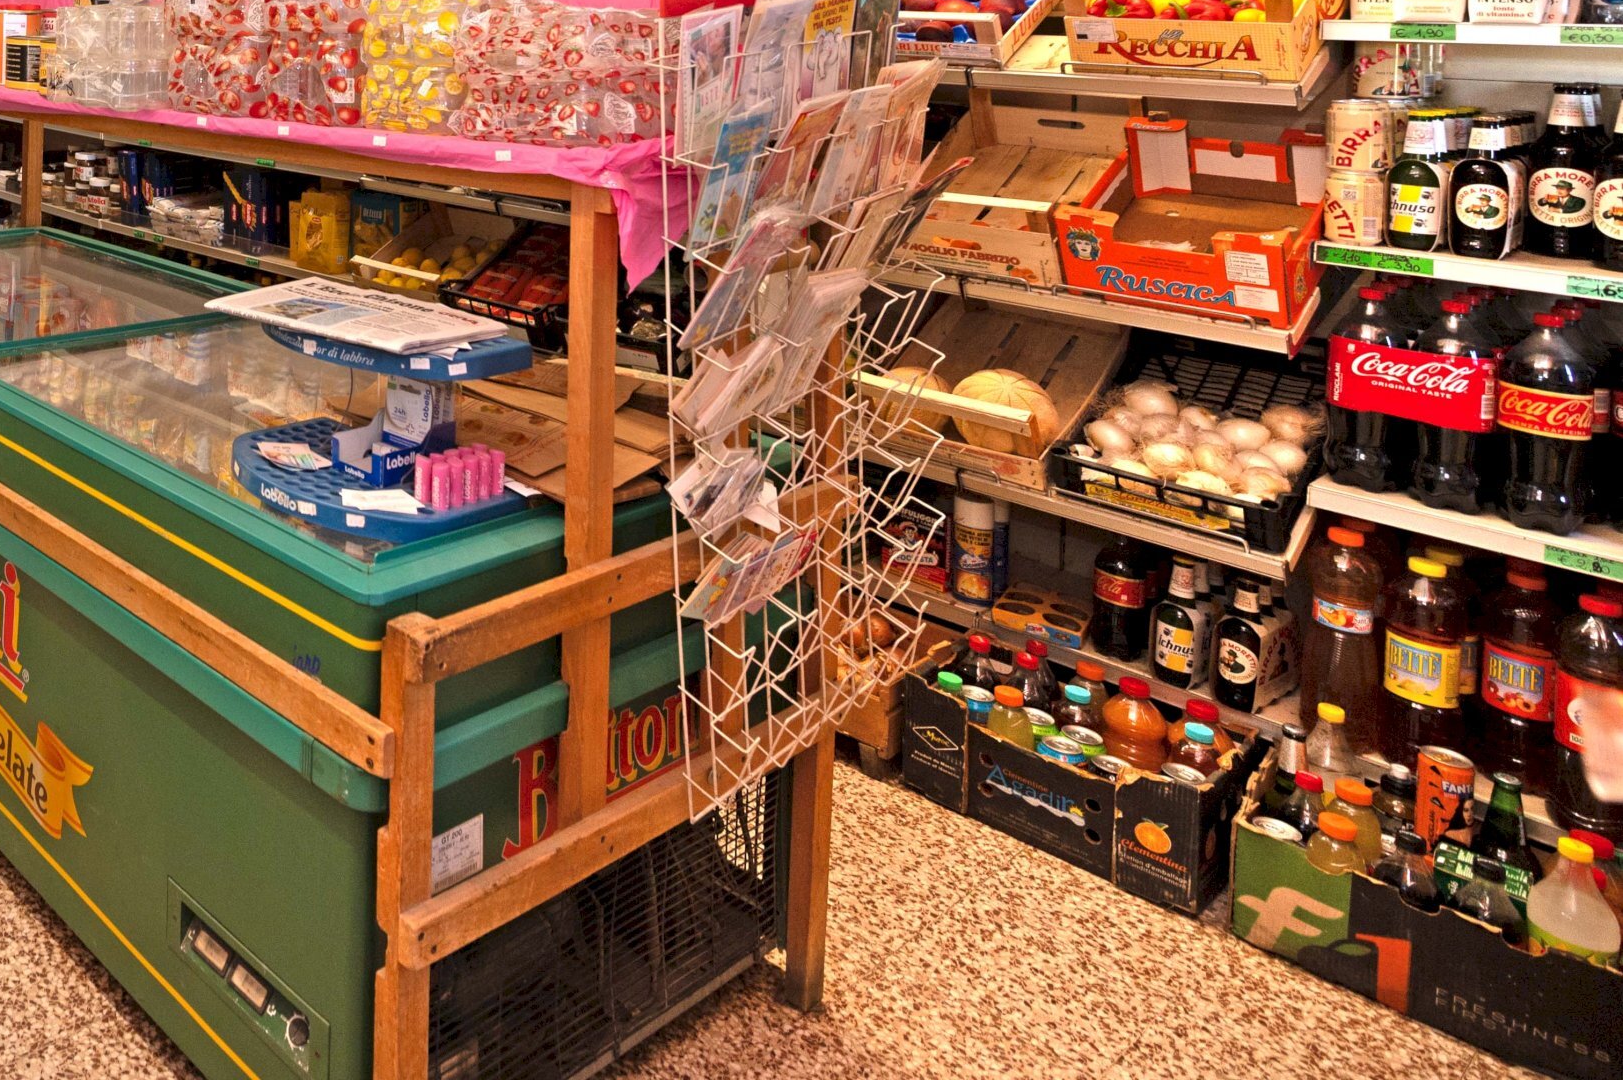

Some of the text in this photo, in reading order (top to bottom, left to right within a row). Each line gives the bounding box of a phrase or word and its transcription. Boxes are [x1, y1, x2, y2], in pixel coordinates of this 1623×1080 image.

[1485, 10, 1523, 19] vitamina
[1093, 29, 1261, 62] RECCHIA
[1415, 28, 1445, 39] 1,90
[1529, 169, 1552, 197] BIRRA
[1326, 199, 1355, 241] ETTI
[960, 248, 1021, 267] FABRIZIO
[1095, 264, 1237, 307] RUSCICA
[327, 346, 376, 367] di labbra
[1332, 362, 1341, 402] RICICLAMI
[1351, 351, 1477, 395] Coca-Cola
[1371, 379, 1453, 400] ORIGINAL TASTE
[393, 406, 406, 416] 24h
[422, 388, 431, 423] Labello
[1510, 418, 1541, 432] SENZA
[344, 465, 365, 480] Labello
[260, 482, 298, 513] Labello
[986, 764, 1079, 813] Agadir
[441, 827, 463, 846] GT 200
[1434, 986, 1612, 1064] FRESHNESS
